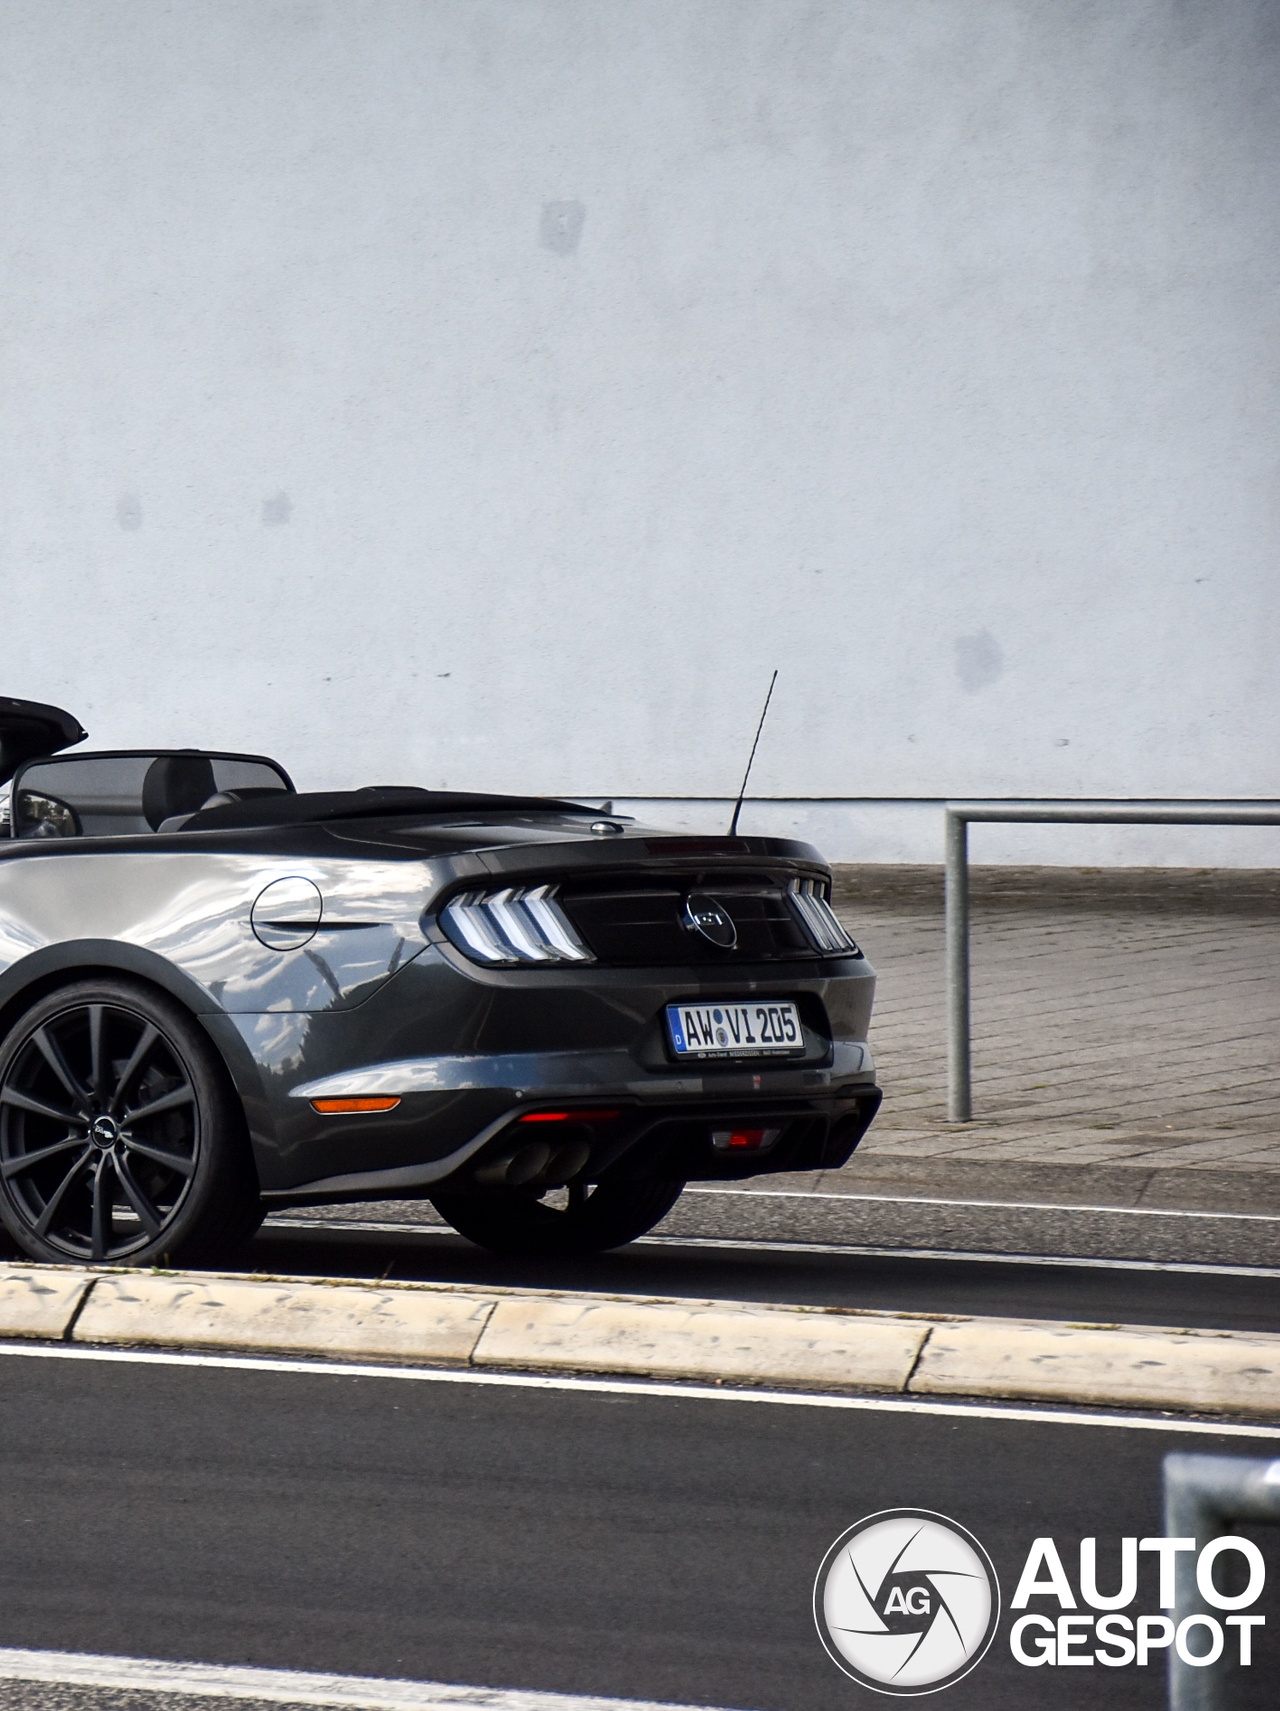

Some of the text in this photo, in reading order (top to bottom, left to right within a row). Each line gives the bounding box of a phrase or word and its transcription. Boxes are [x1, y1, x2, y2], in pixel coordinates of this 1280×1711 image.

[675, 1006, 797, 1047] D AW VI 205
